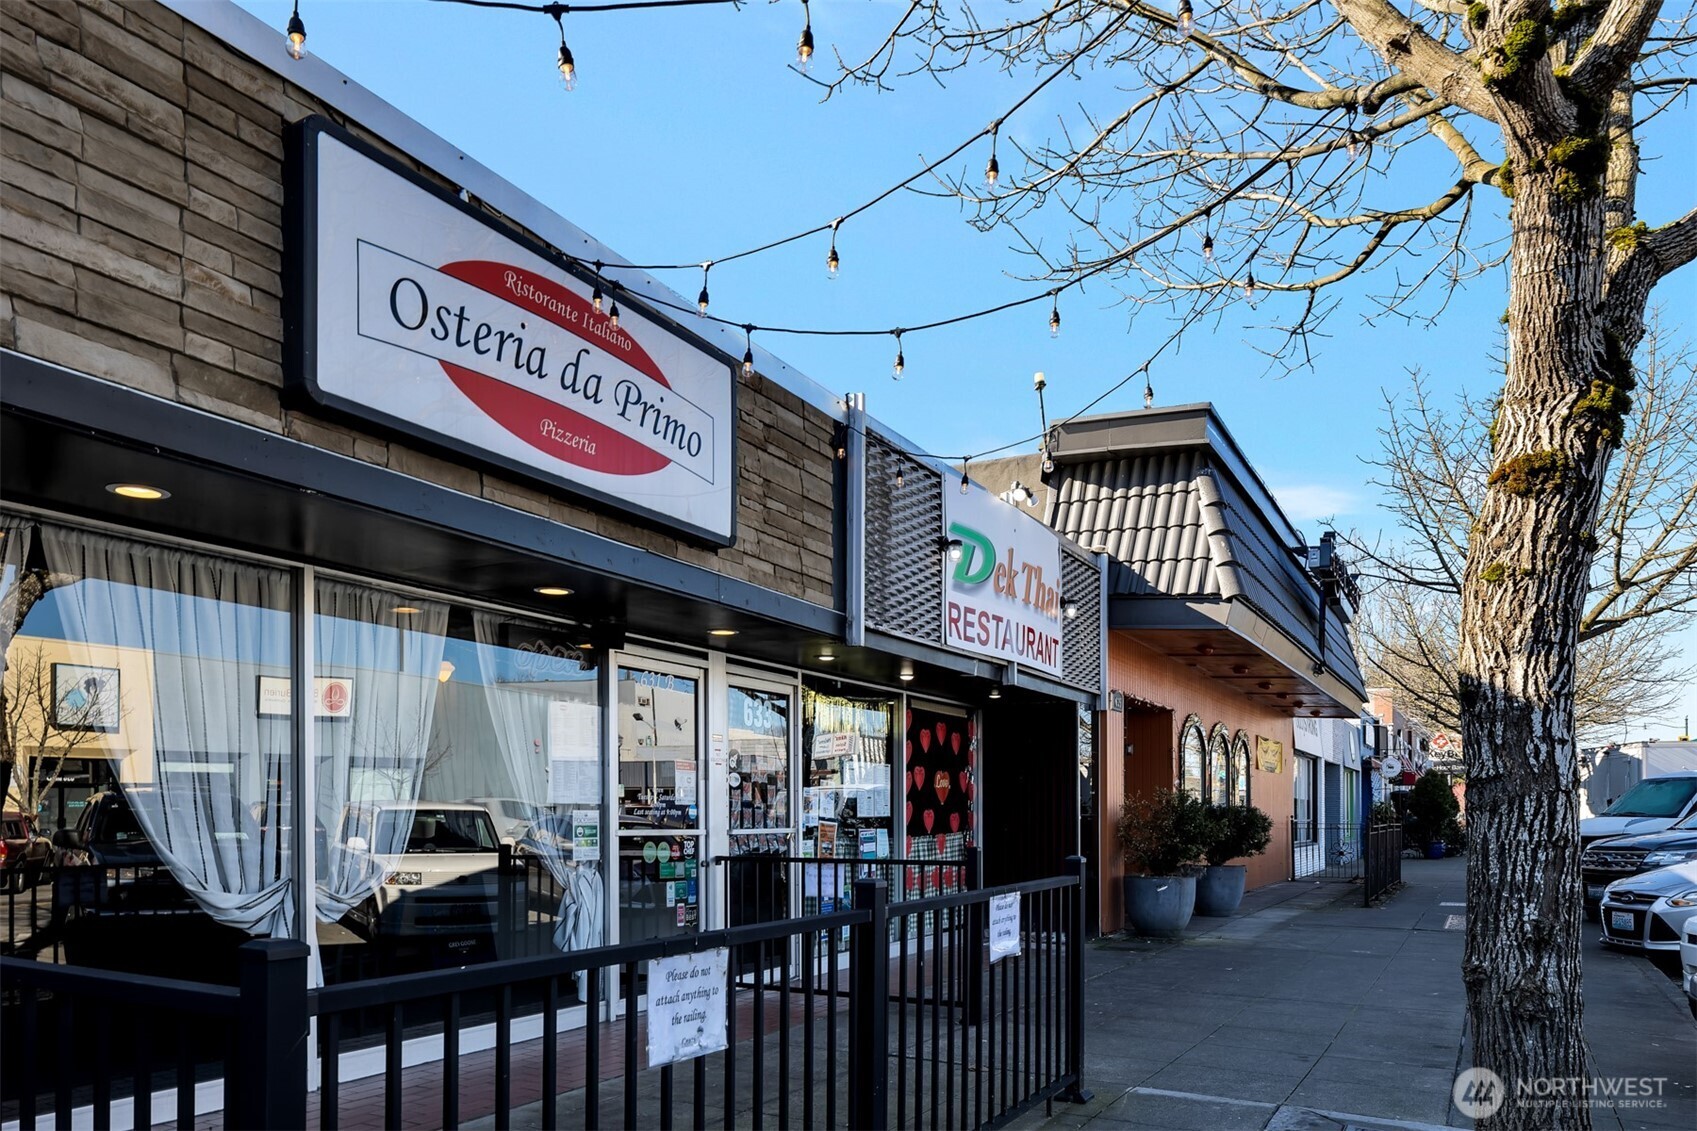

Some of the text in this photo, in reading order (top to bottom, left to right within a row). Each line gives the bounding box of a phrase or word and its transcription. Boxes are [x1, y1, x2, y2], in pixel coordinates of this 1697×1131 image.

[504, 270, 632, 352] Ristorante Italiano
[389, 277, 702, 458] Osteria da Primo
[539, 418, 597, 456] Pizzeria
[949, 521, 1060, 614] Dek Thai
[948, 601, 1060, 669] RESTAURANT
[641, 670, 661, 688] 631
[743, 697, 772, 728] 633
[683, 840, 695, 849] TOP
[683, 848, 696, 856] CHEF
[665, 965, 711, 982] Please do not
[655, 985, 720, 1007] attach anything to
[671, 1011, 682, 1026] the
